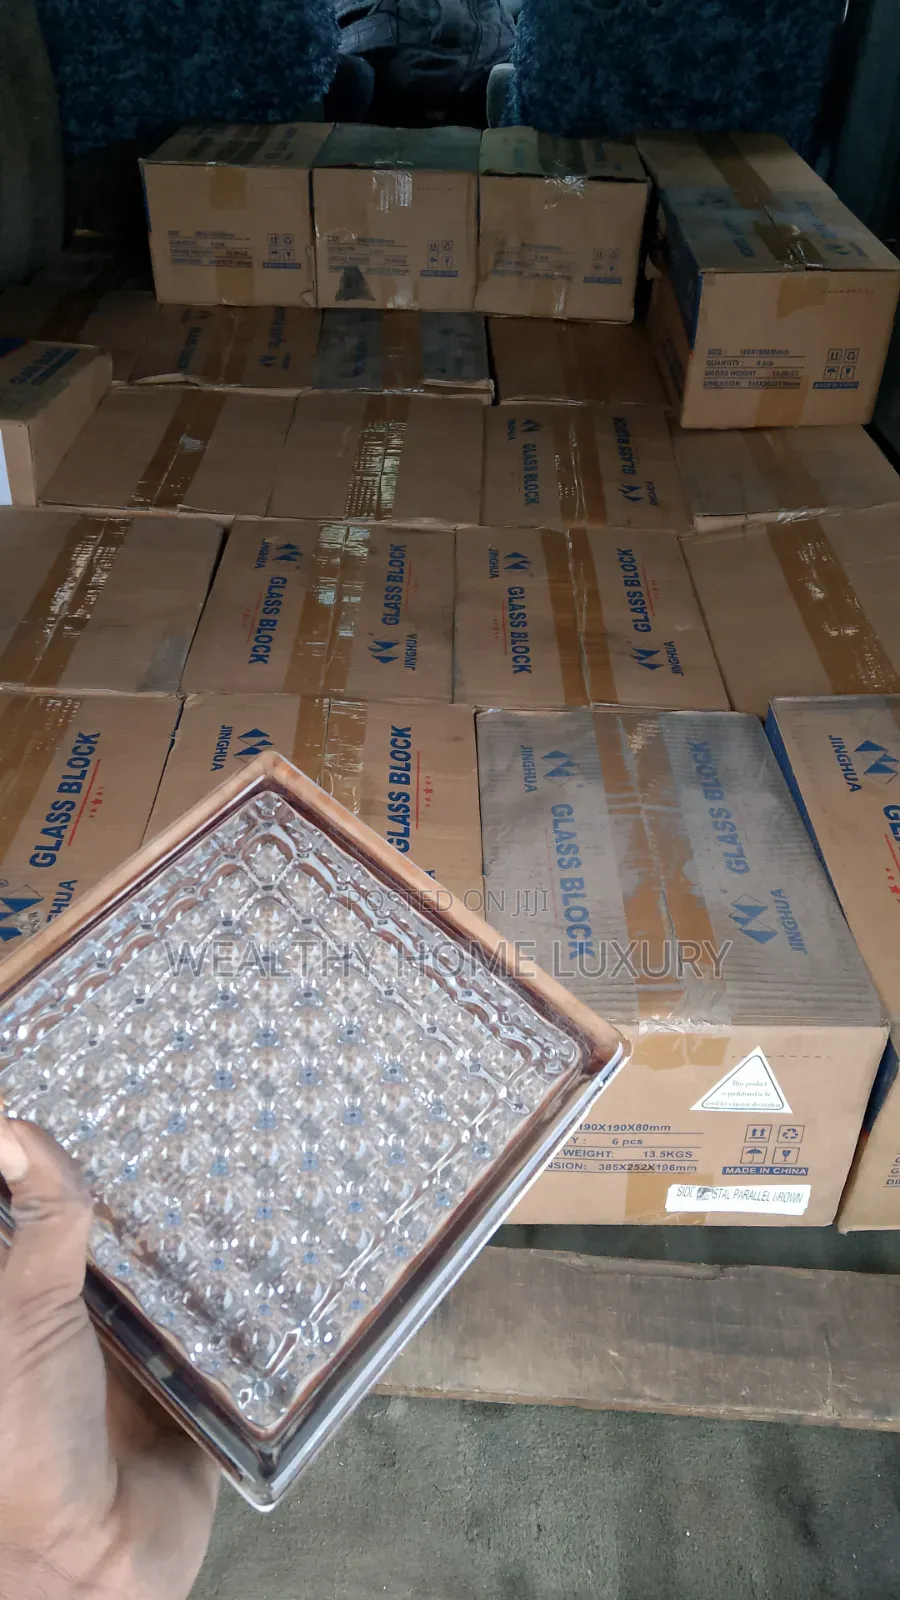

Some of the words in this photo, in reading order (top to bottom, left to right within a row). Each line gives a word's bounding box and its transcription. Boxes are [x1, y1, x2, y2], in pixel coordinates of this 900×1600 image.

[522, 444, 538, 472] GLASS
[618, 445, 637, 475] GLASS
[524, 473, 540, 506] BLOCK
[385, 544, 407, 584] BLOCK
[488, 547, 500, 579] JINGHUA
[616, 548, 642, 588] BLOCK
[262, 576, 288, 615] GLASS
[381, 584, 403, 626] GLASS
[507, 586, 528, 628] GLASS
[626, 590, 652, 633] GLASS
[248, 618, 278, 665] BLOCK
[404, 634, 418, 671] JINGHUA
[510, 631, 532, 674] BLOCK
[664, 640, 684, 676] JINGHUA
[210, 724, 234, 771] JINGHUA
[388, 724, 412, 786] BLOCK
[520, 744, 538, 793] JINGHUA
[828, 734, 862, 792] JINGHUA
[686, 738, 725, 801] BLOCK
[29, 800, 76, 868] GLASS
[56, 731, 101, 794] BLOCK
[387, 791, 411, 854] GLASS
[550, 803, 582, 870] GLASS
[708, 807, 750, 875] GLASS
[559, 876, 596, 960] BLOCK
[769, 888, 808, 956] JINGHUA
[579, 1123, 671, 1132] 190X190X80mm
[612, 1138, 619, 1146] 6
[622, 1139, 644, 1147] pcs
[563, 1150, 614, 1158] WEIGHT:
[642, 1150, 693, 1158] 13.5KGS
[598, 1164, 697, 1172] 385X252X196mm
[676, 1186, 696, 1198] SIDE
[732, 1189, 770, 1202] PARALLEL
